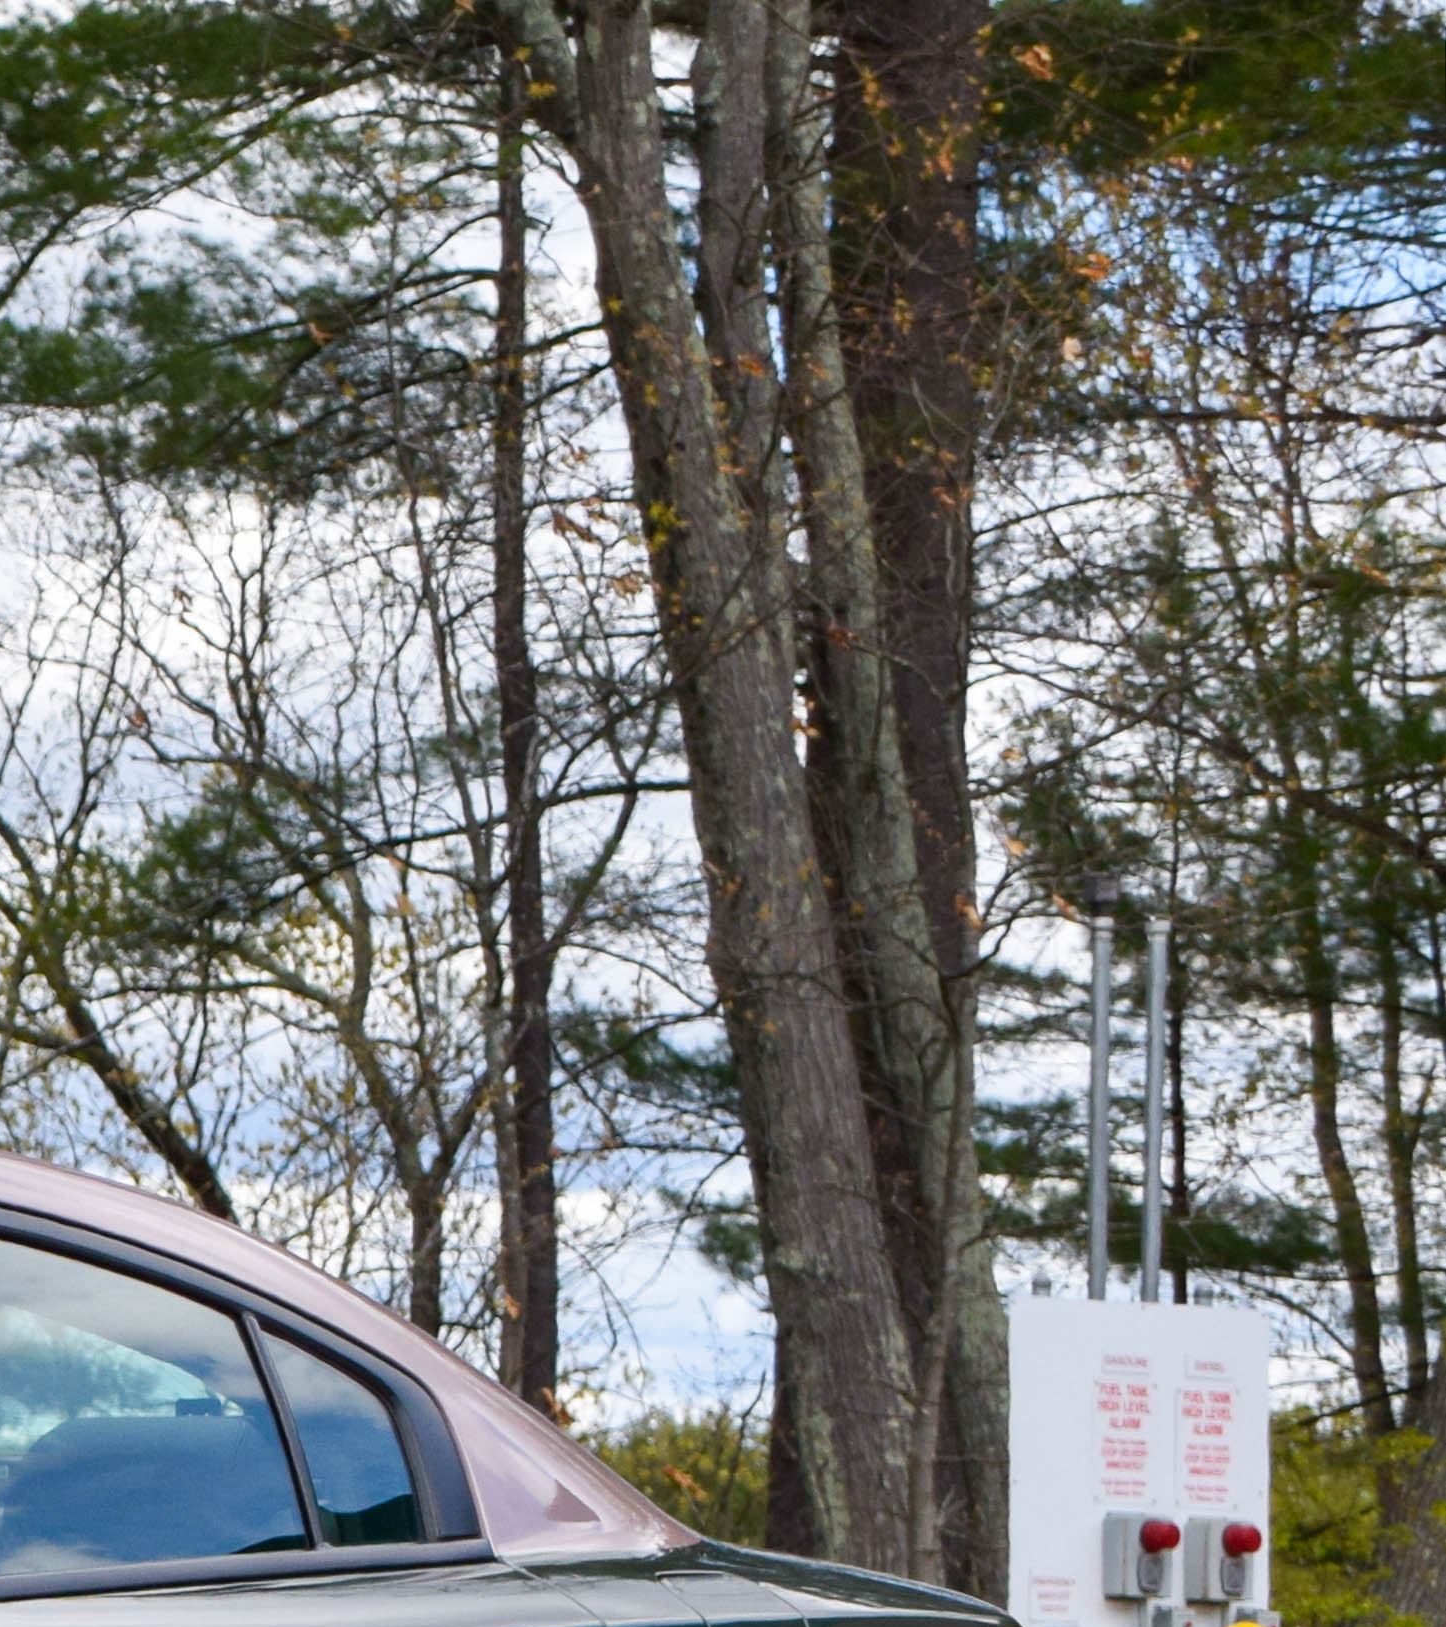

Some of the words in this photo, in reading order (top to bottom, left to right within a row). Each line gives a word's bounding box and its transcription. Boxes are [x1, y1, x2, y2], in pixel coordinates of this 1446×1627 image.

[1099, 1383, 1121, 1396] FUEL
[1127, 1384, 1148, 1397] TANK
[1183, 1391, 1204, 1403] FUEL
[1209, 1391, 1231, 1404] TANK
[1097, 1399, 1119, 1411] HIGH
[1124, 1400, 1151, 1414] LEVEL
[1205, 1407, 1232, 1420] LEVEL
[1109, 1416, 1141, 1429] ALARM
[1193, 1422, 1223, 1435] ALARM
